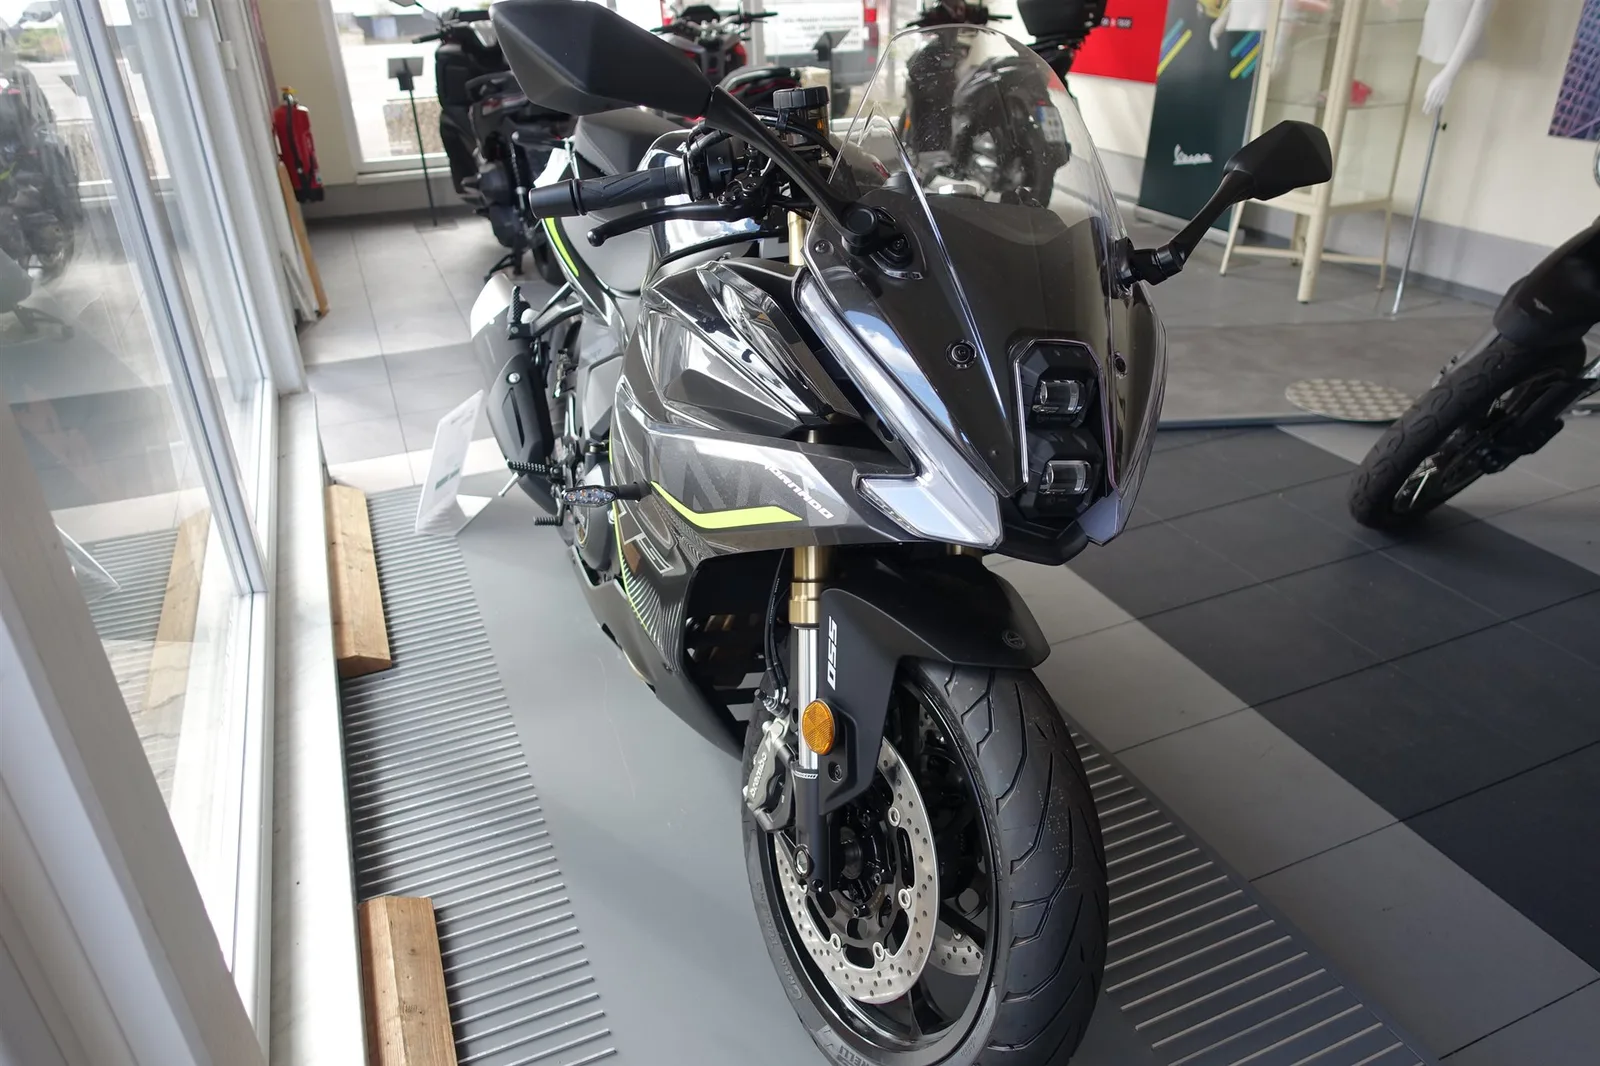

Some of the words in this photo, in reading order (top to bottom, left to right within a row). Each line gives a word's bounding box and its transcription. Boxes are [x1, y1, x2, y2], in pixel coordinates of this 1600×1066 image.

[827, 615, 838, 691] 550
[749, 752, 767, 798] brembo
[839, 1045, 870, 1066] RELLI
